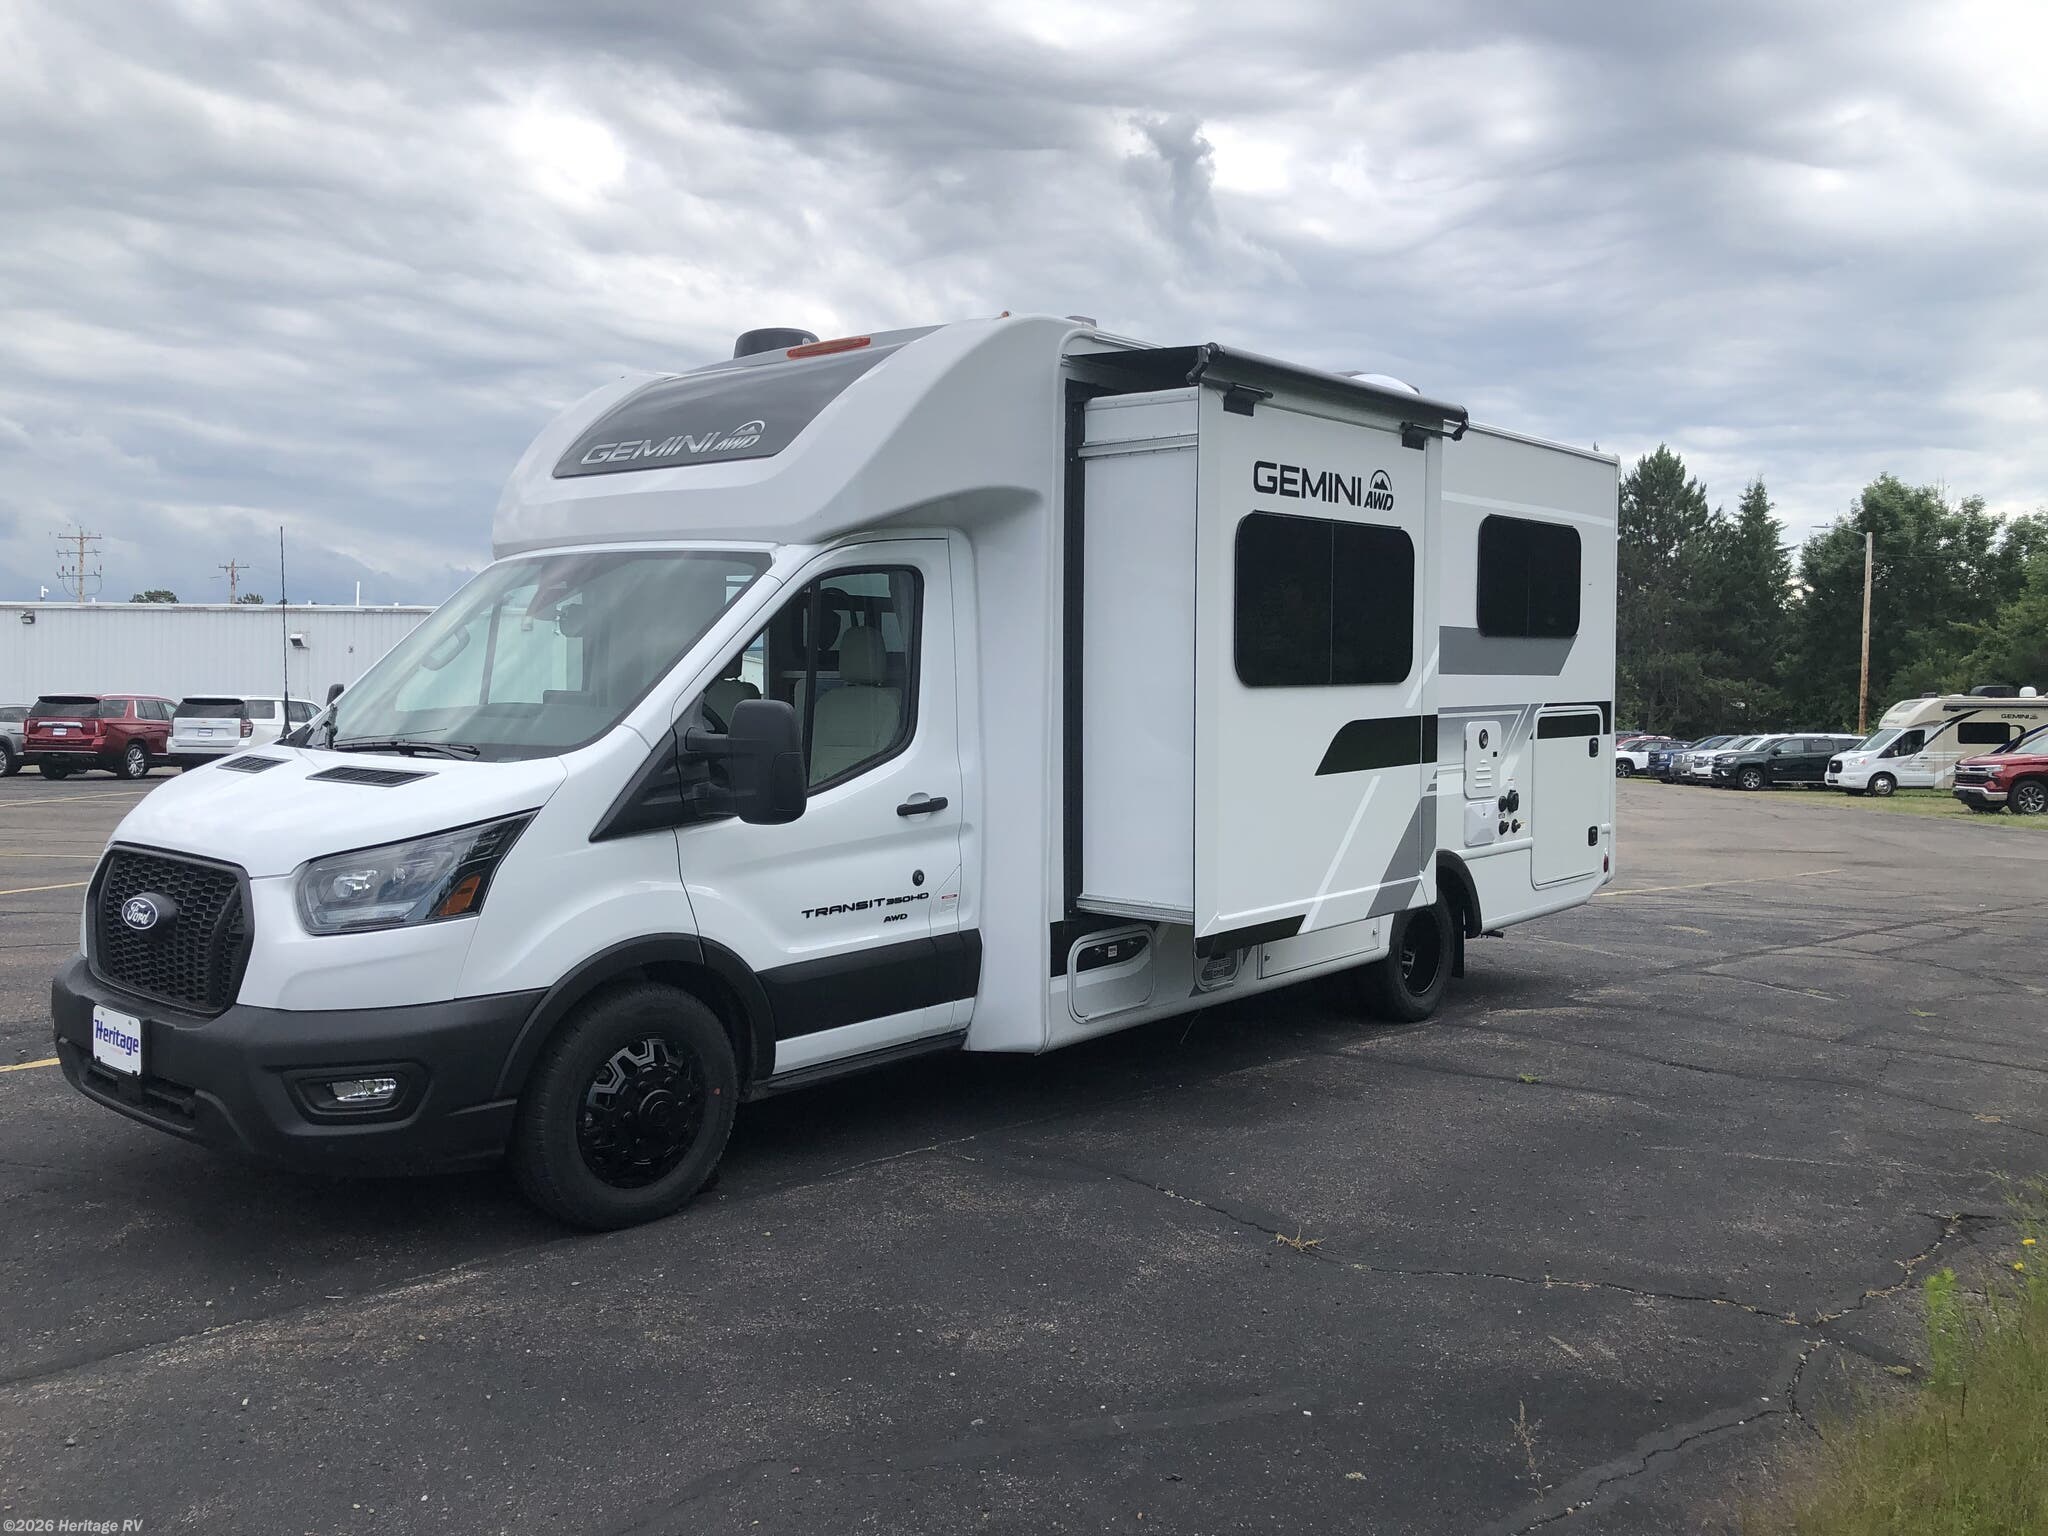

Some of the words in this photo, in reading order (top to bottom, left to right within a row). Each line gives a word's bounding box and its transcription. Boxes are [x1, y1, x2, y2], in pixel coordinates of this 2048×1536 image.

[581, 432, 721, 465] GEMINI
[715, 434, 761, 451] AWD
[1253, 460, 1362, 507] GEMINI
[1363, 490, 1394, 511] AWD
[127, 901, 151, 925] Ford
[883, 913, 908, 923] AWD
[94, 1019, 139, 1056] Heritage
